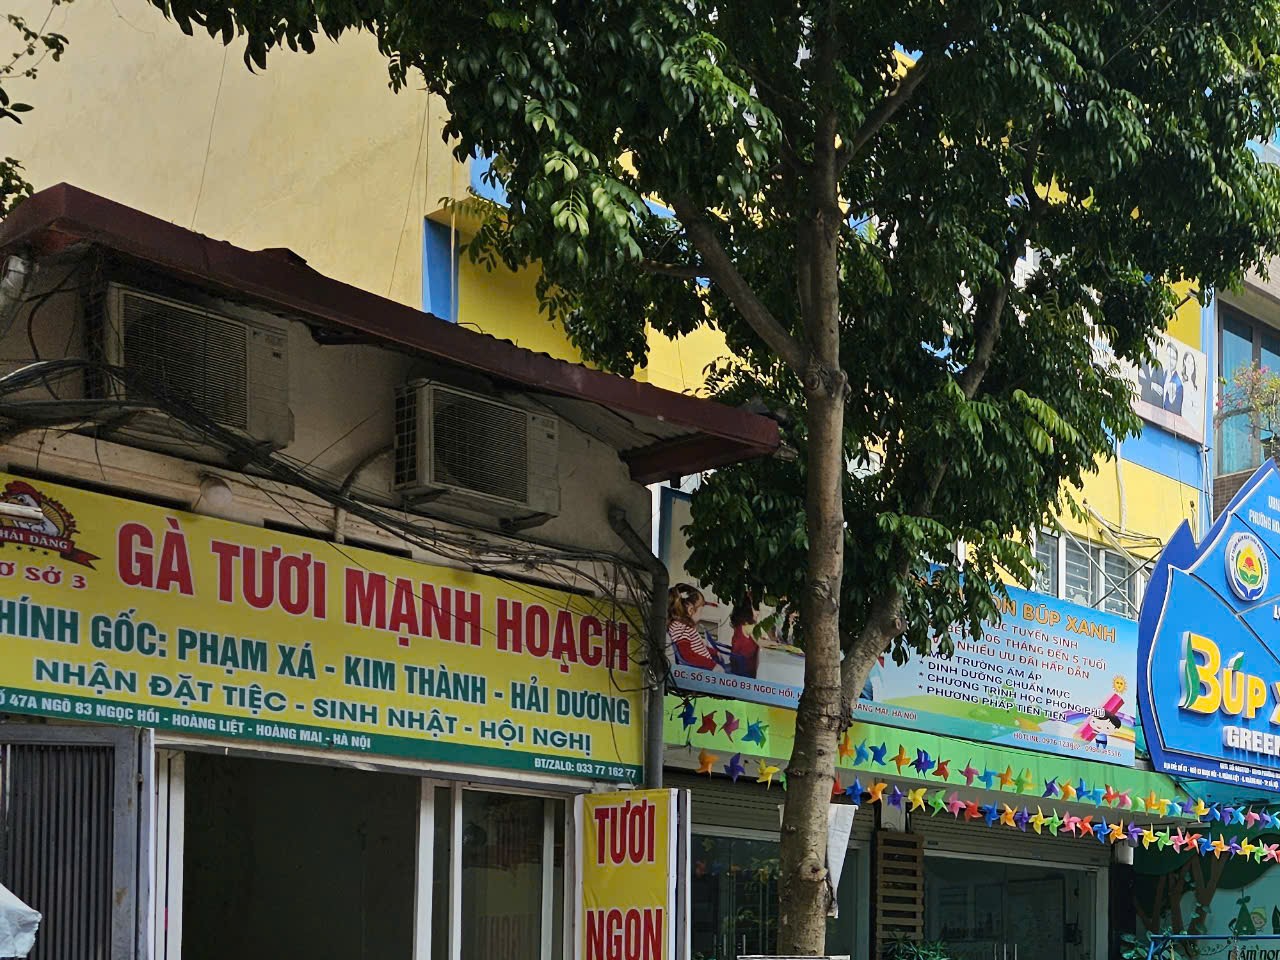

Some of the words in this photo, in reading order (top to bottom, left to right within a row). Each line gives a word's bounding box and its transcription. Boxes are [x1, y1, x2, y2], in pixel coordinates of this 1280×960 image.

[0, 561, 15, 577] Ơ
[25, 566, 62, 585] SỞ
[72, 575, 87, 589] 3
[117, 517, 194, 595] GÀ
[211, 540, 326, 619] TƯƠI
[345, 567, 481, 647] MẠNH
[496, 598, 628, 673] HOẠCH
[1023, 604, 1060, 627] BÚP
[1066, 615, 1116, 643] XANH
[1005, 638, 1044, 655] THÁNG
[1052, 636, 1078, 649] SINH
[0, 596, 79, 644] HÍNH
[91, 608, 168, 657] GỐC:
[177, 628, 268, 675] PHẠM
[277, 643, 316, 680] XÁ
[345, 655, 395, 691] KIM
[404, 665, 486, 704] THÀNH
[511, 676, 548, 713] HẢI
[557, 688, 630, 725] DƯƠNG
[674, 670, 688, 679] ĐC:
[928, 661, 958, 675] DINH
[1027, 669, 1042, 681] ÁP
[1178, 631, 1267, 719] BÚP
[35, 659, 137, 695] NHẬN
[149, 673, 214, 706] ĐẶT
[222, 684, 287, 714] TIỆC
[313, 699, 378, 724] SINH
[388, 709, 457, 737] NHẬT
[480, 719, 524, 746] HỘI
[532, 729, 591, 756] NGHỊ
[927, 673, 979, 691] CHƯƠNG
[1020, 693, 1043, 705] HỌC
[1045, 699, 1082, 713] PHONG
[927, 686, 979, 704] PHƯƠNG
[982, 696, 1013, 710] PHÁP
[9, 694, 37, 709] 47A
[41, 697, 70, 713] NGÕ
[75, 702, 92, 715] 83
[96, 704, 133, 721] NGỌC
[172, 713, 216, 731] HOÀNG
[219, 719, 244, 735] LIỆT
[256, 723, 297, 740] HOÀNG
[300, 730, 322, 743] MAI
[333, 731, 348, 747] HÀ
[351, 735, 371, 750] NỘI
[535, 758, 575, 772] ĐT/ZALO:
[576, 762, 593, 774] 033
[596, 764, 607, 775] 77
[608, 765, 624, 777] 162
[625, 768, 636, 778] 77
[594, 799, 655, 865] TƯƠI
